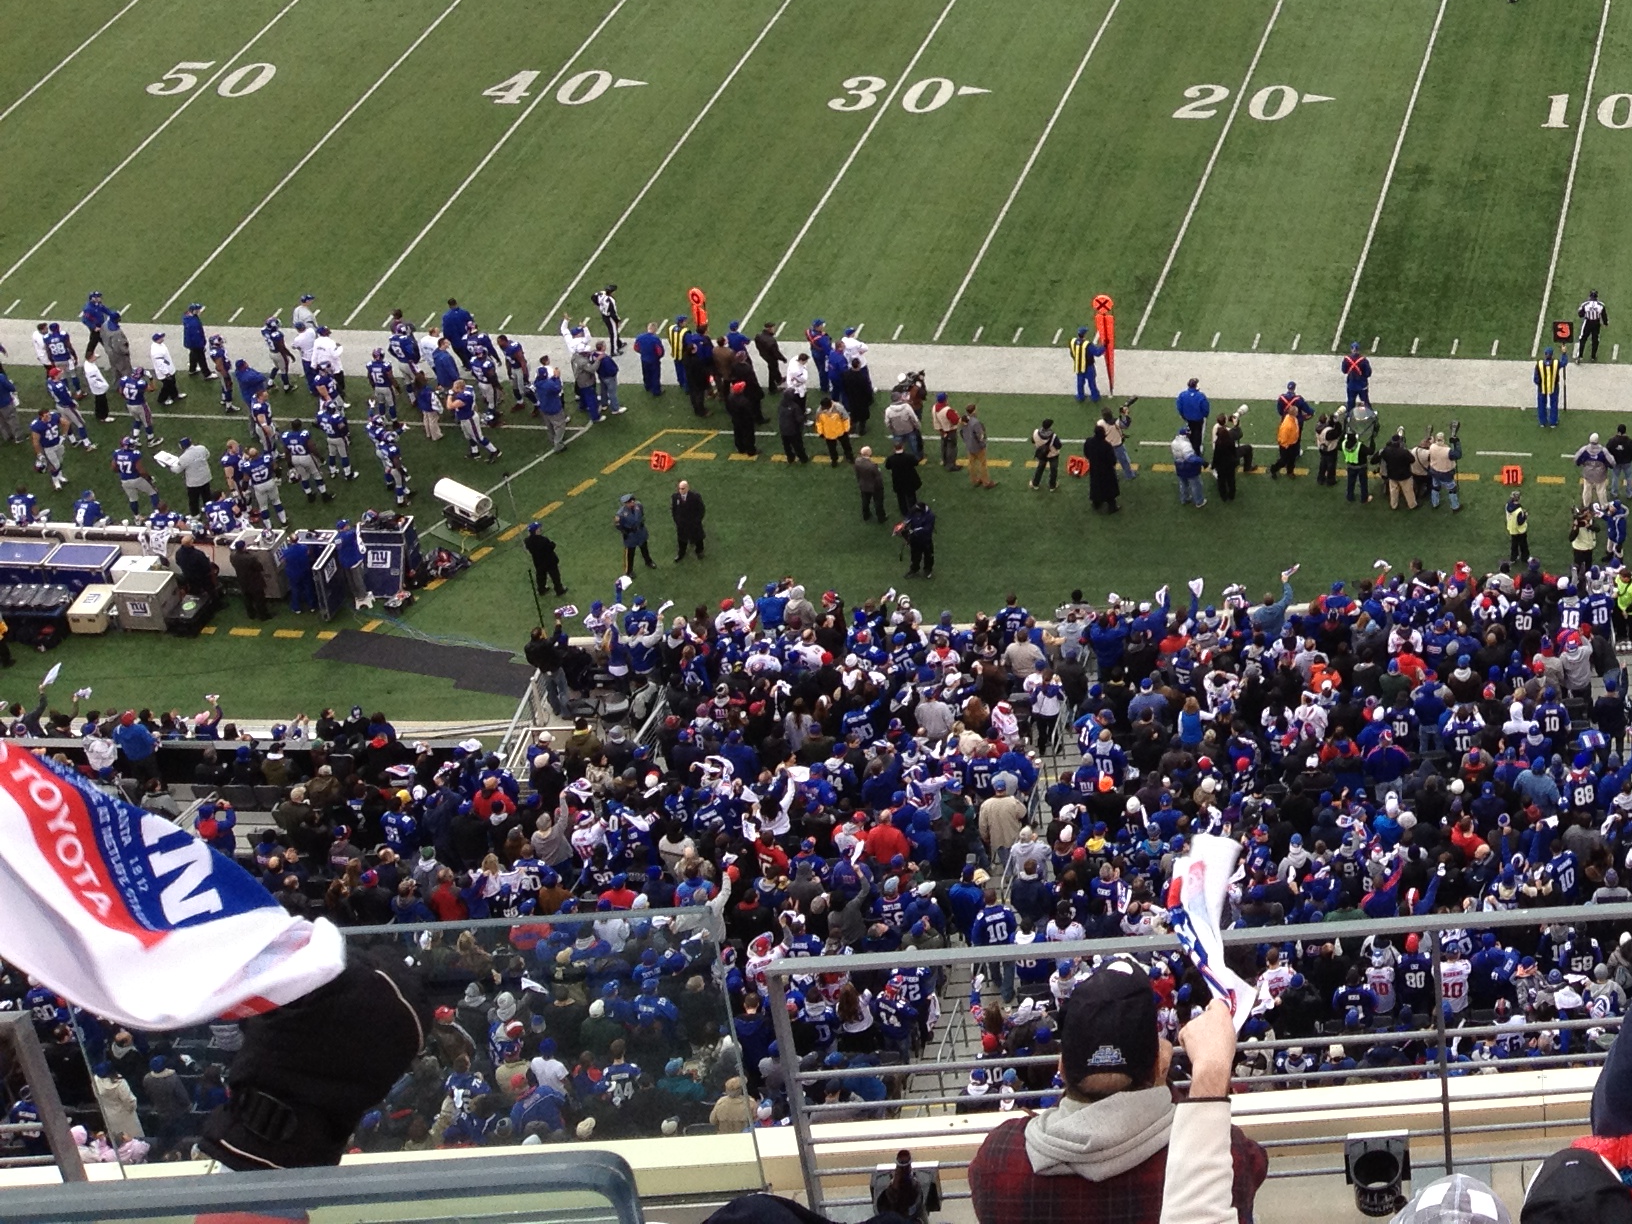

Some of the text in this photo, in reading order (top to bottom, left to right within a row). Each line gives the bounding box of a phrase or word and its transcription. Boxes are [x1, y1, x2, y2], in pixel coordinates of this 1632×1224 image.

[145, 62, 277, 98] 50
[481, 70, 608, 105] 40
[826, 75, 958, 115] 30
[1172, 84, 1298, 121] 20
[1557, 322, 1571, 338] 3
[371, 370, 387, 384] 15
[122, 388, 138, 401] 47
[45, 425, 60, 440] 45
[117, 460, 133, 474] 77
[651, 451, 666, 471] 30
[251, 467, 269, 481] 67
[1503, 467, 1522, 484] 10
[209, 511, 230, 525] 76
[1515, 615, 1532, 631] 20
[1562, 609, 1580, 628] 10
[1592, 607, 1608, 624] 10
[1545, 716, 1560, 732] 10
[1455, 735, 1471, 752] 10
[1095, 758, 1114, 774] 10
[1574, 786, 1595, 806] 88
[10, 759, 113, 918] TOYOTA
[1558, 872, 1576, 892] 10
[986, 922, 1009, 943] 10
[1405, 971, 1426, 989] 80
[1442, 982, 1463, 998] 10
